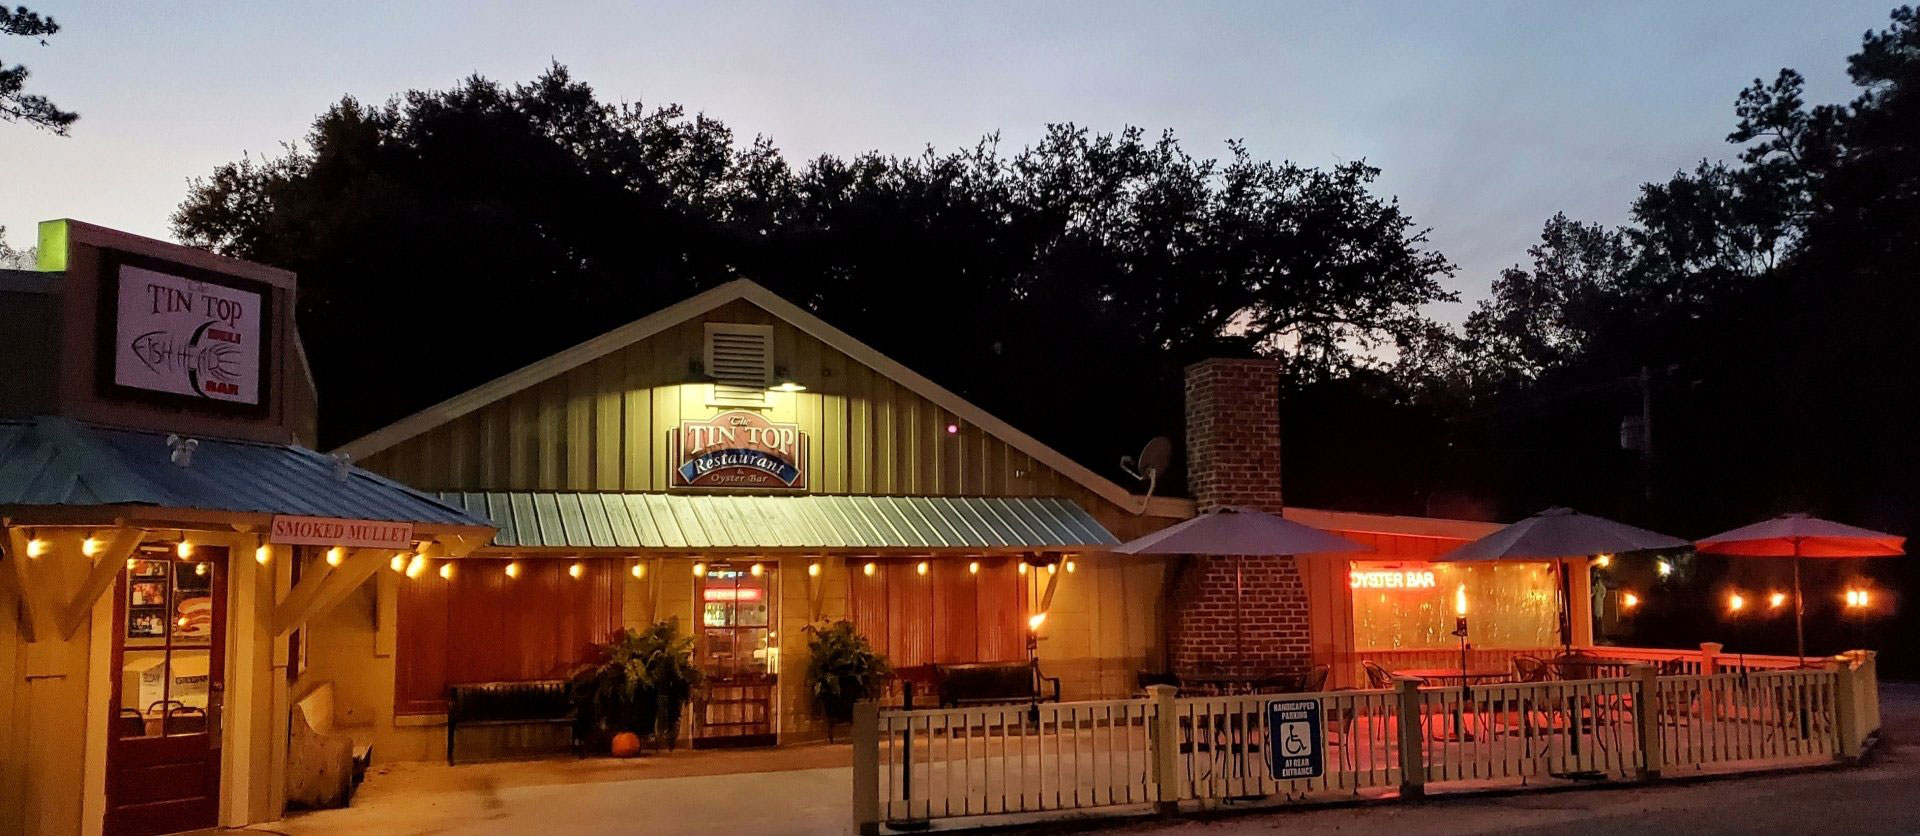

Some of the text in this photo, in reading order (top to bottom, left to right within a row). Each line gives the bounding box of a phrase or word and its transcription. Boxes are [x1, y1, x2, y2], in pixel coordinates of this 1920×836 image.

[147, 284, 243, 328] TIN TOP
[205, 380, 239, 395] BAR
[728, 415, 752, 427] The
[688, 425, 794, 455] TIN TOP
[694, 452, 785, 475] Restaurant
[711, 473, 768, 484] Oyster Bar
[275, 520, 409, 542] SMOKED MULLET
[1350, 571, 1435, 588] OYSTER BAR
[1273, 702, 1315, 712] HANDICAPPED
[1281, 711, 1308, 720] PARKING
[1285, 758, 1309, 767] AT REAR
[1282, 767, 1313, 777] ENTRANCE
